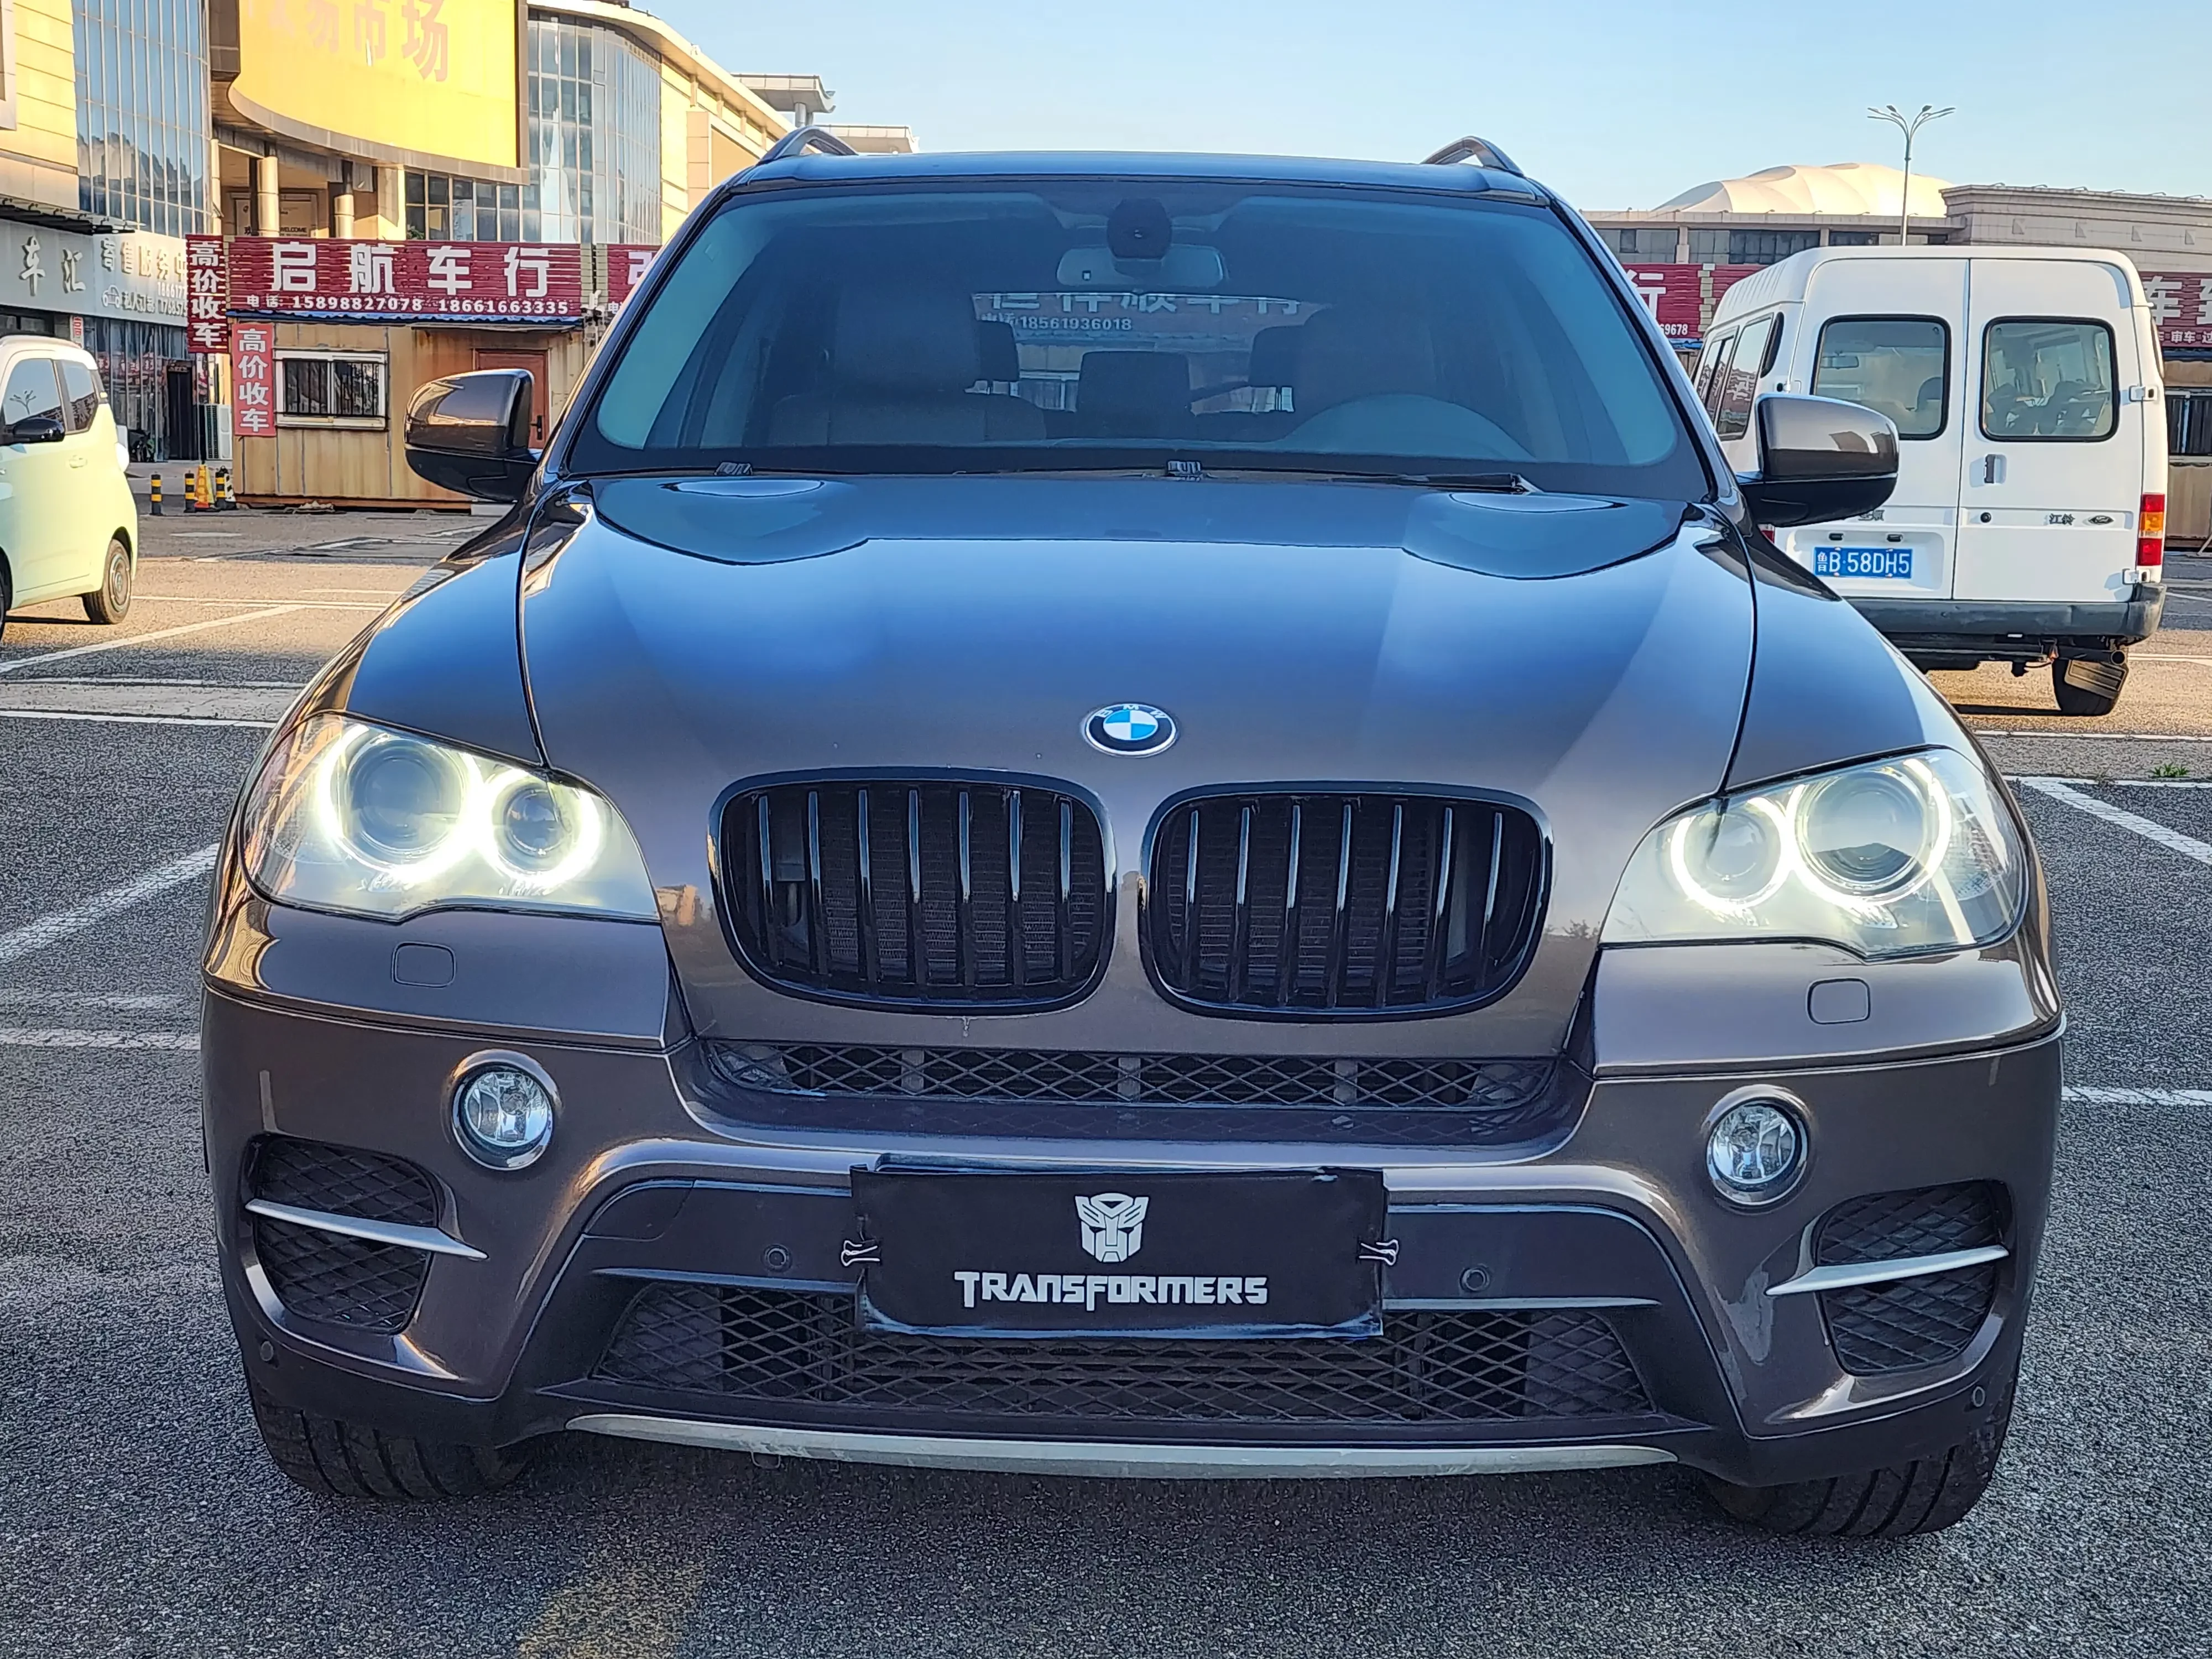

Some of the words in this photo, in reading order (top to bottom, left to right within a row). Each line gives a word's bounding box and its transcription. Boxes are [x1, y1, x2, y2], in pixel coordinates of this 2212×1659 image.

[272, 241, 550, 297] 启航车行
[189, 241, 222, 348] 高价收车
[292, 295, 422, 311] 15898827078
[438, 299, 568, 314] 18661663335
[1020, 316, 1132, 330] 18561936018
[237, 328, 270, 432] 高价收车
[2049, 513, 2075, 526] 江铃
[954, 1271, 1268, 1311] TRANSFORMERS
